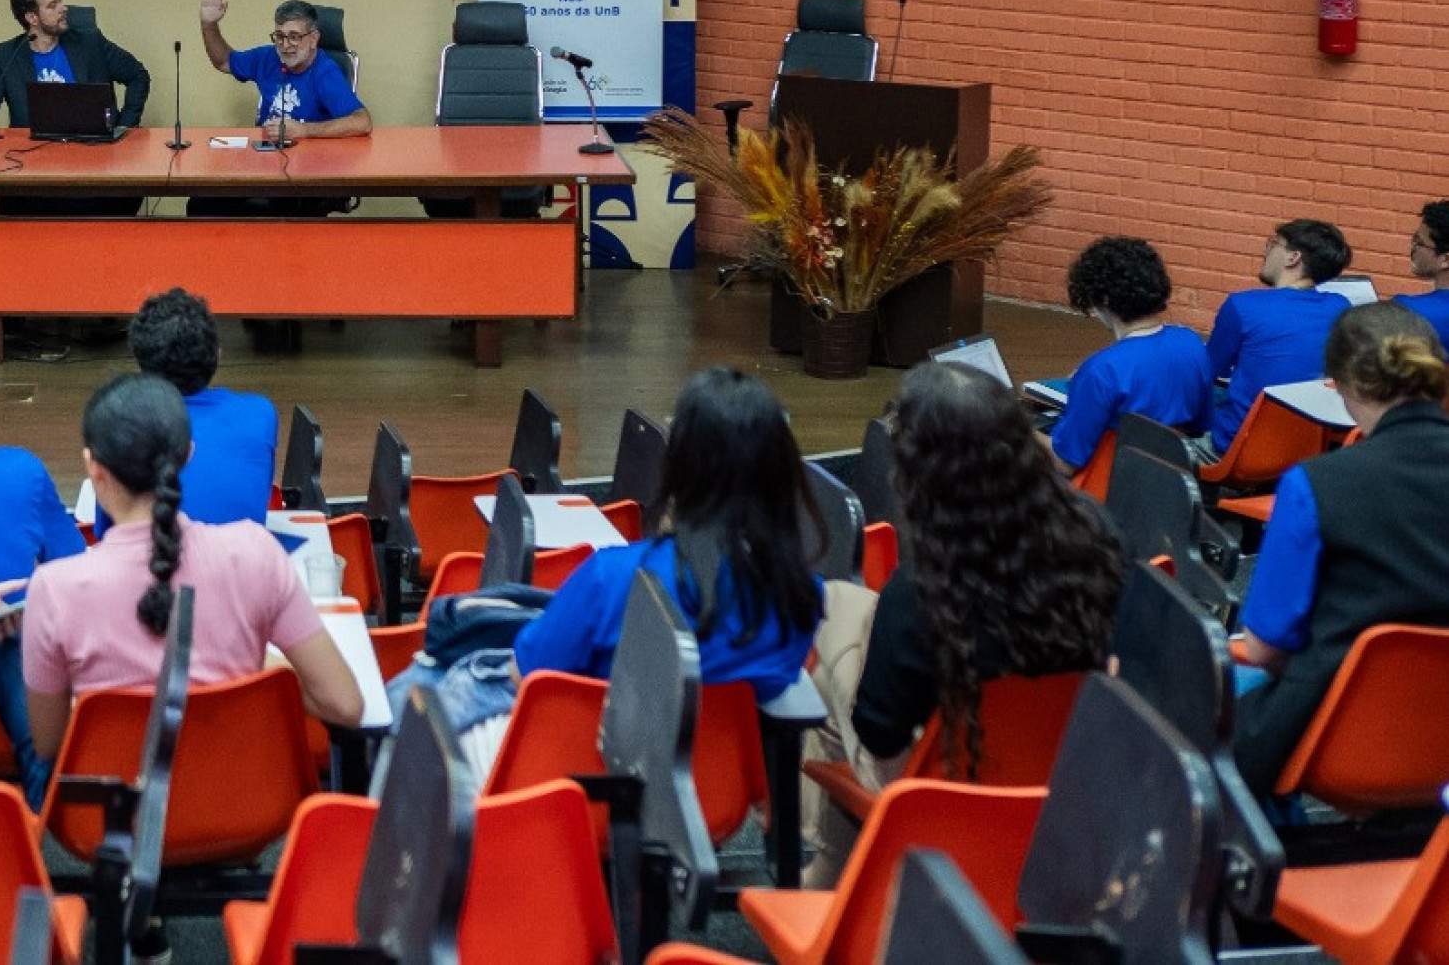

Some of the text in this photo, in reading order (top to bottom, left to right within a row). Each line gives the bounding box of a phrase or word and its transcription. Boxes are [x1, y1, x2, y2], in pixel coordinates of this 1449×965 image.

[540, 7, 571, 16] anos
[575, 6, 590, 16] da
[595, 6, 621, 16] UnB
